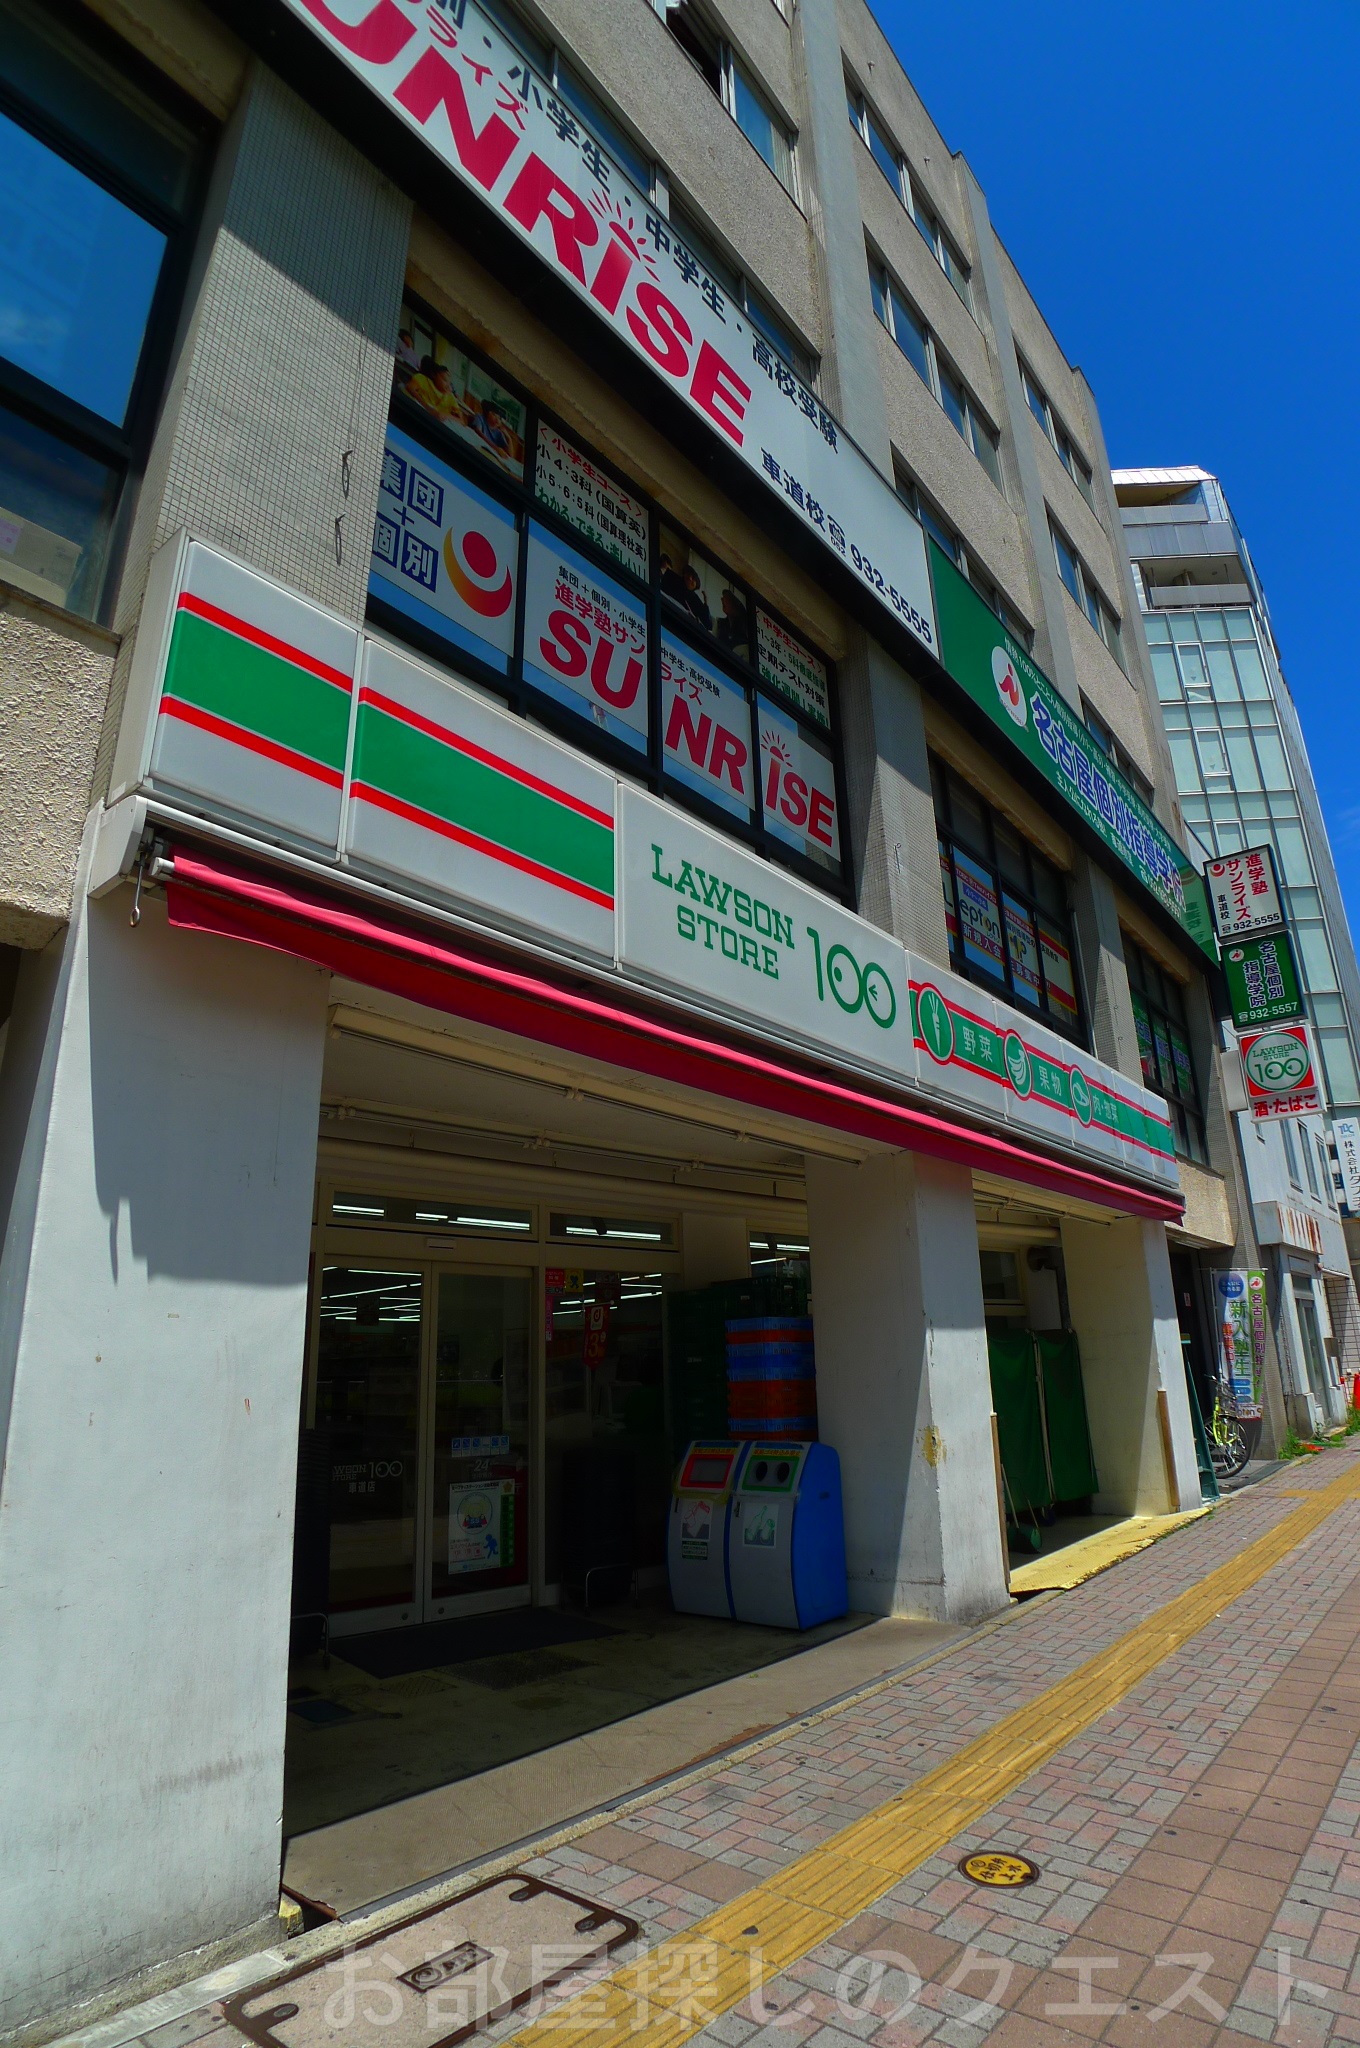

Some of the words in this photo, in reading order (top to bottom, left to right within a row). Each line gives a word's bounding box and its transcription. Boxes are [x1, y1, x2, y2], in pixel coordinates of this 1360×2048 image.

[761, 446, 826, 533] 車道校
[850, 543, 933, 645] 932-5555
[539, 608, 645, 710] SU
[664, 694, 748, 796] NR
[1226, 858, 1252, 922] サンライズ
[1245, 853, 1269, 896] 進学塾
[651, 843, 795, 951] LAWSON
[1217, 894, 1231, 920] 車道校
[1233, 912, 1281, 931] 932-5555
[676, 903, 781, 981] STORE
[963, 924, 1002, 960] 新規入会
[807, 926, 898, 1030] 100
[1242, 959, 1267, 1008] 指導学院
[1258, 940, 1285, 1000] 名古屋個別
[1249, 1001, 1298, 1020] 932-5557
[962, 1026, 993, 1064] 野菜
[1252, 1042, 1299, 1058] LAWSON
[1263, 1051, 1290, 1061] STORE
[1039, 1065, 1064, 1097] 果物
[1254, 1057, 1304, 1082] 100
[1253, 1093, 1319, 1117] 酒・たばこ
